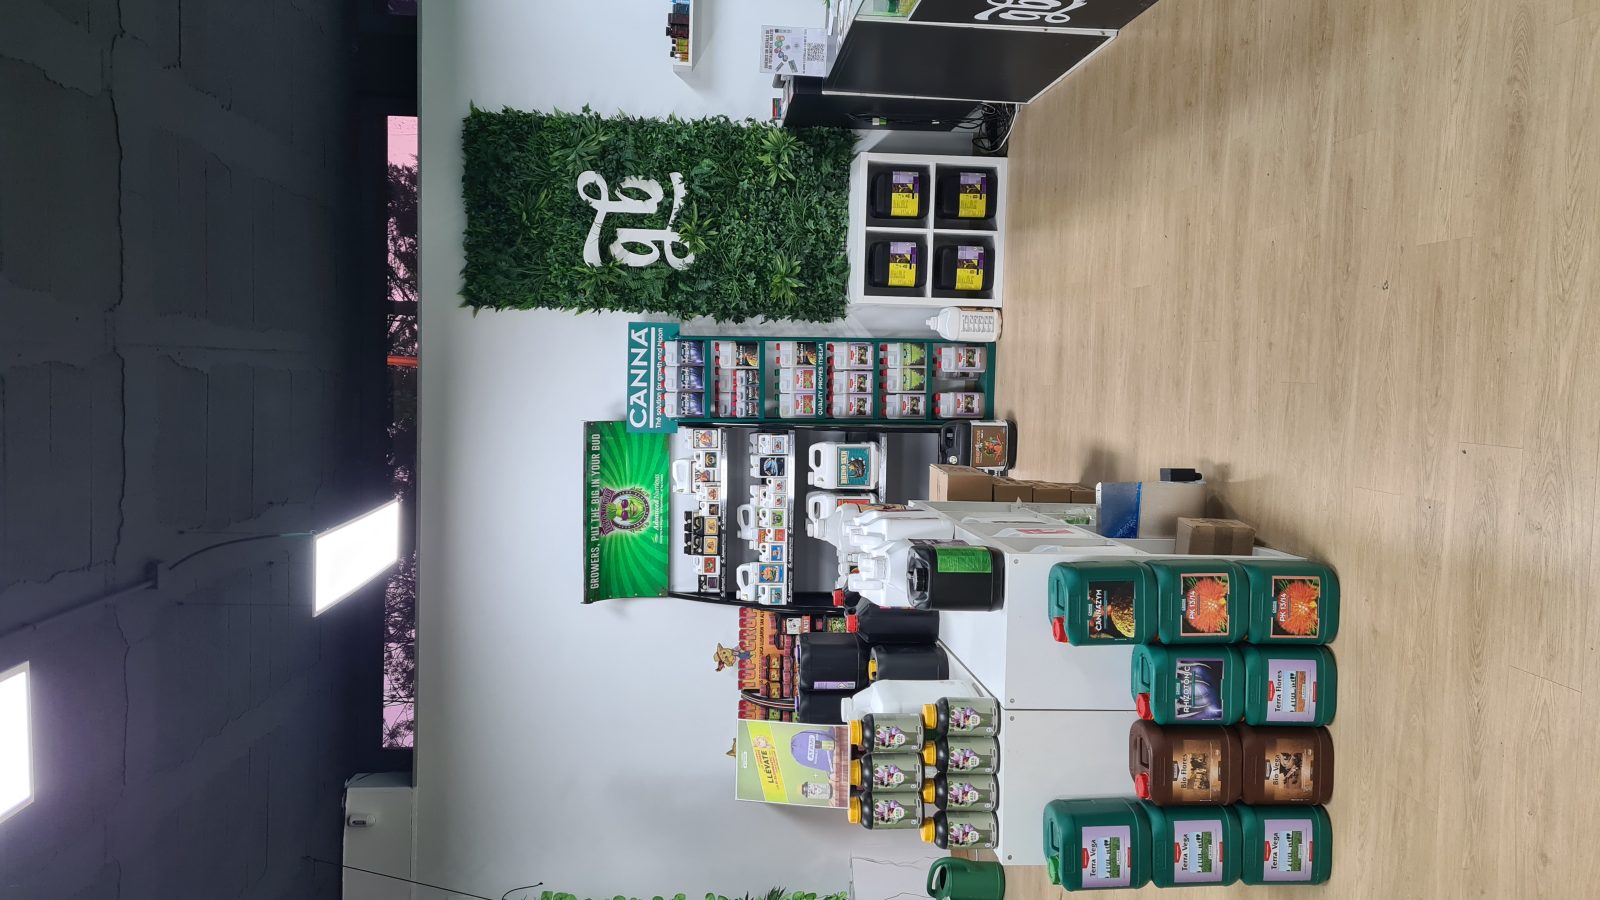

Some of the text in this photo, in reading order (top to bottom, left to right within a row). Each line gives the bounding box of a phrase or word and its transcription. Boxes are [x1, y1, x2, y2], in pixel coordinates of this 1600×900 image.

[629, 327, 648, 428] CANNA
[591, 434, 600, 450] BUD
[591, 454, 600, 476] YOUR
[591, 490, 600, 504] BIG
[591, 508, 599, 522] THE
[591, 526, 599, 541] PUT
[590, 544, 600, 589] GROWERS,
[1189, 609, 1195, 619] PK
[1280, 612, 1286, 622] PK
[738, 607, 757, 690] TOP CROP
[738, 700, 756, 719] OP
[761, 750, 774, 784] LLÉVATE
